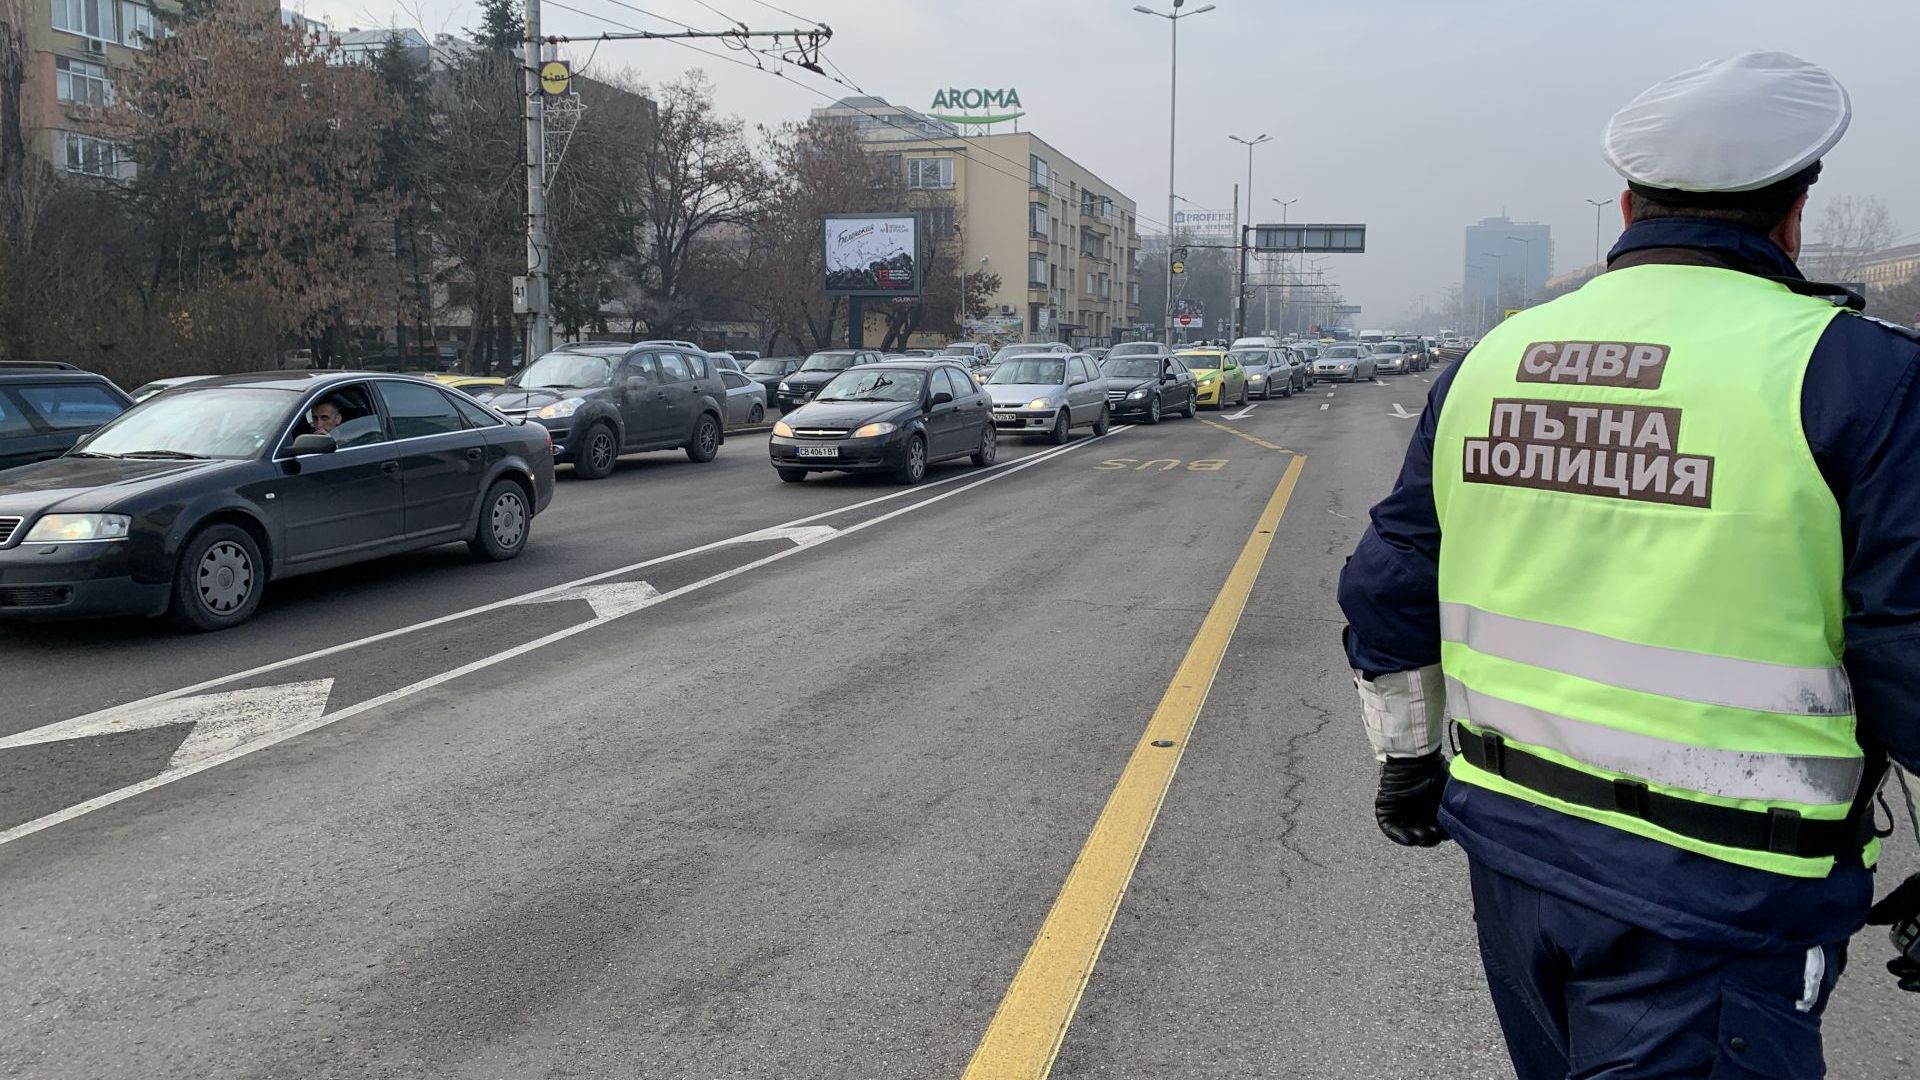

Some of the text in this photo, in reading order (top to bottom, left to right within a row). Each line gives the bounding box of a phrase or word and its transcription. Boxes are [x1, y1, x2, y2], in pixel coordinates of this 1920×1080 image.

[931, 87, 1022, 109] AROMA
[513, 286, 524, 296] 41
[1523, 343, 1664, 383] СДВР
[1493, 403, 1671, 450] ПЪТНА
[1093, 458, 1230, 471] BUS
[1465, 440, 1708, 497] ПОЛИЦИЯ
